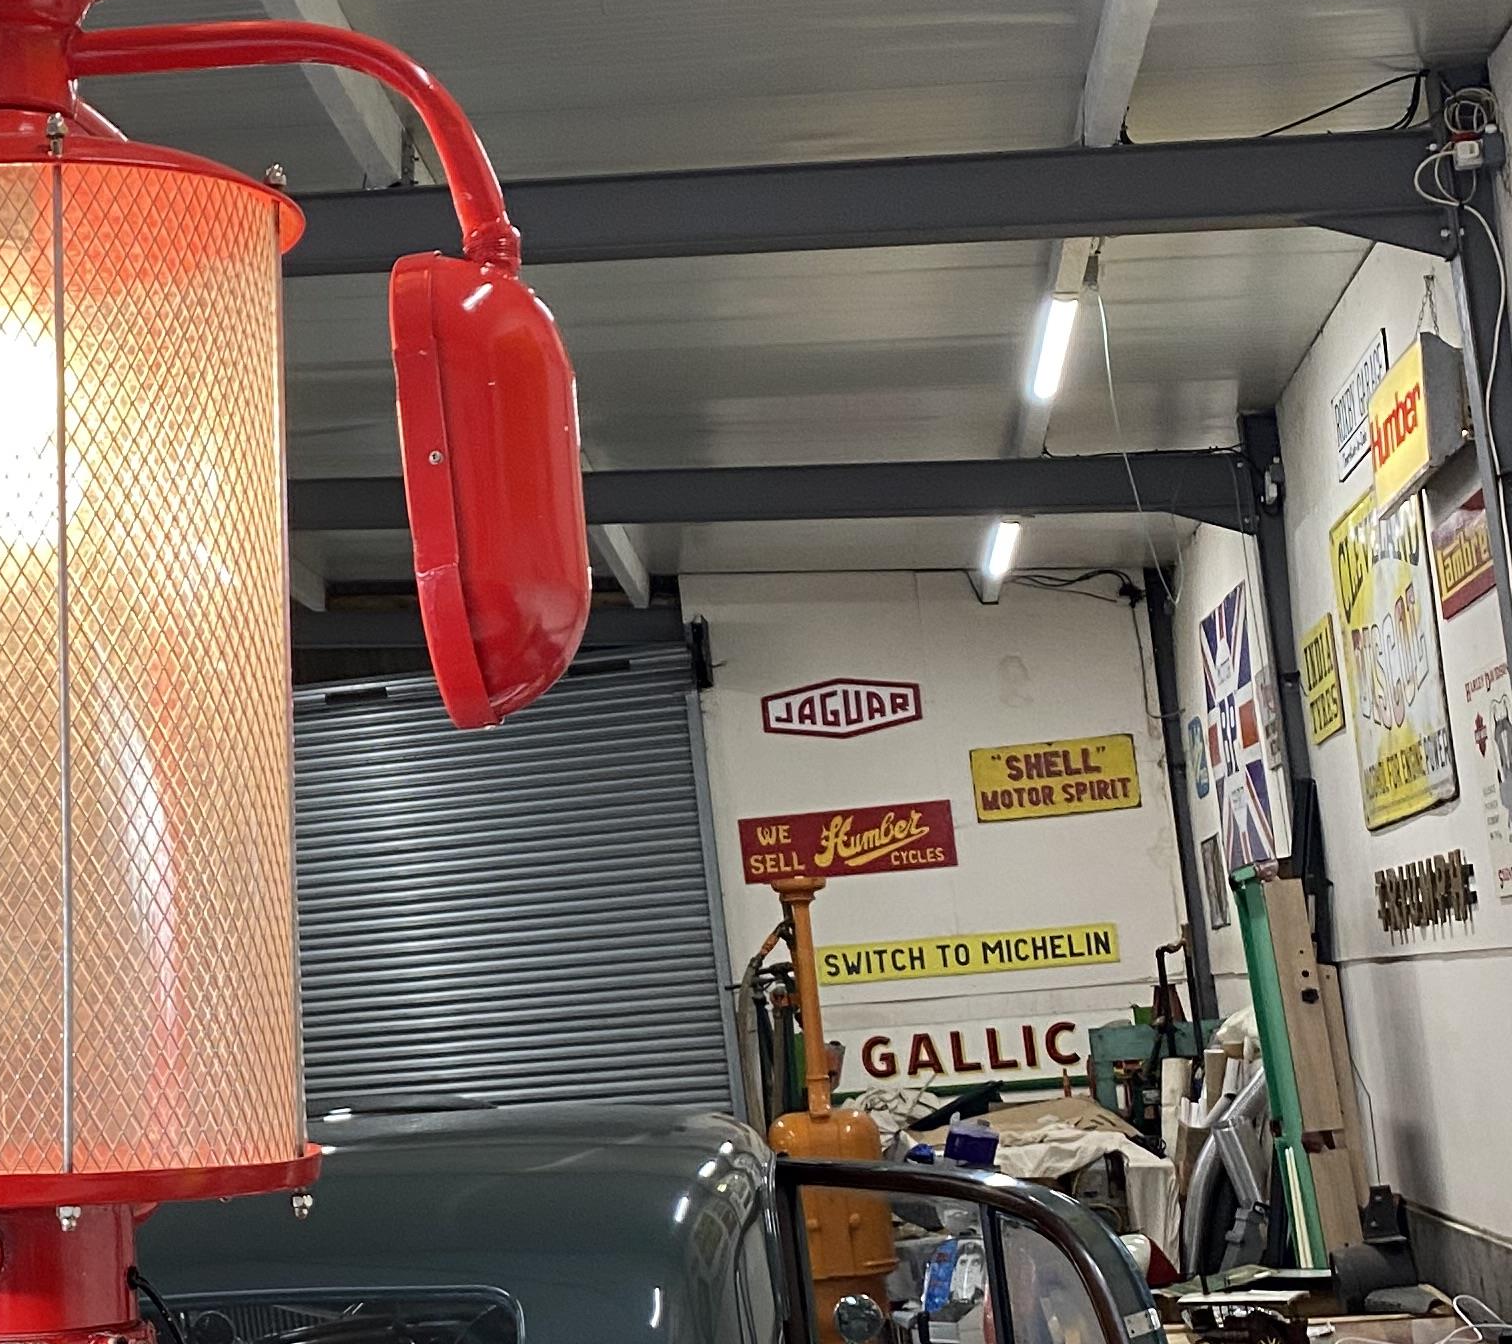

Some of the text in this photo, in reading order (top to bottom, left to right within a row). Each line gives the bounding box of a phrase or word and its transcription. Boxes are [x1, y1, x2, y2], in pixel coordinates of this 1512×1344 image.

[1369, 381, 1421, 473] Humber
[1303, 627, 1334, 692] INDIA
[774, 690, 910, 726] JAGUAR
[1309, 683, 1339, 735] TYRES
[1218, 692, 1240, 778] BP
[981, 775, 1132, 812] MOTOR SPIRIT
[756, 822, 792, 848] WE
[813, 808, 930, 869] Humber
[890, 846, 945, 866] CYCLES
[749, 847, 806, 875] SELL
[824, 929, 1112, 978] SWITCH TO MICHELIN
[861, 1020, 1081, 1080] GALLIC
